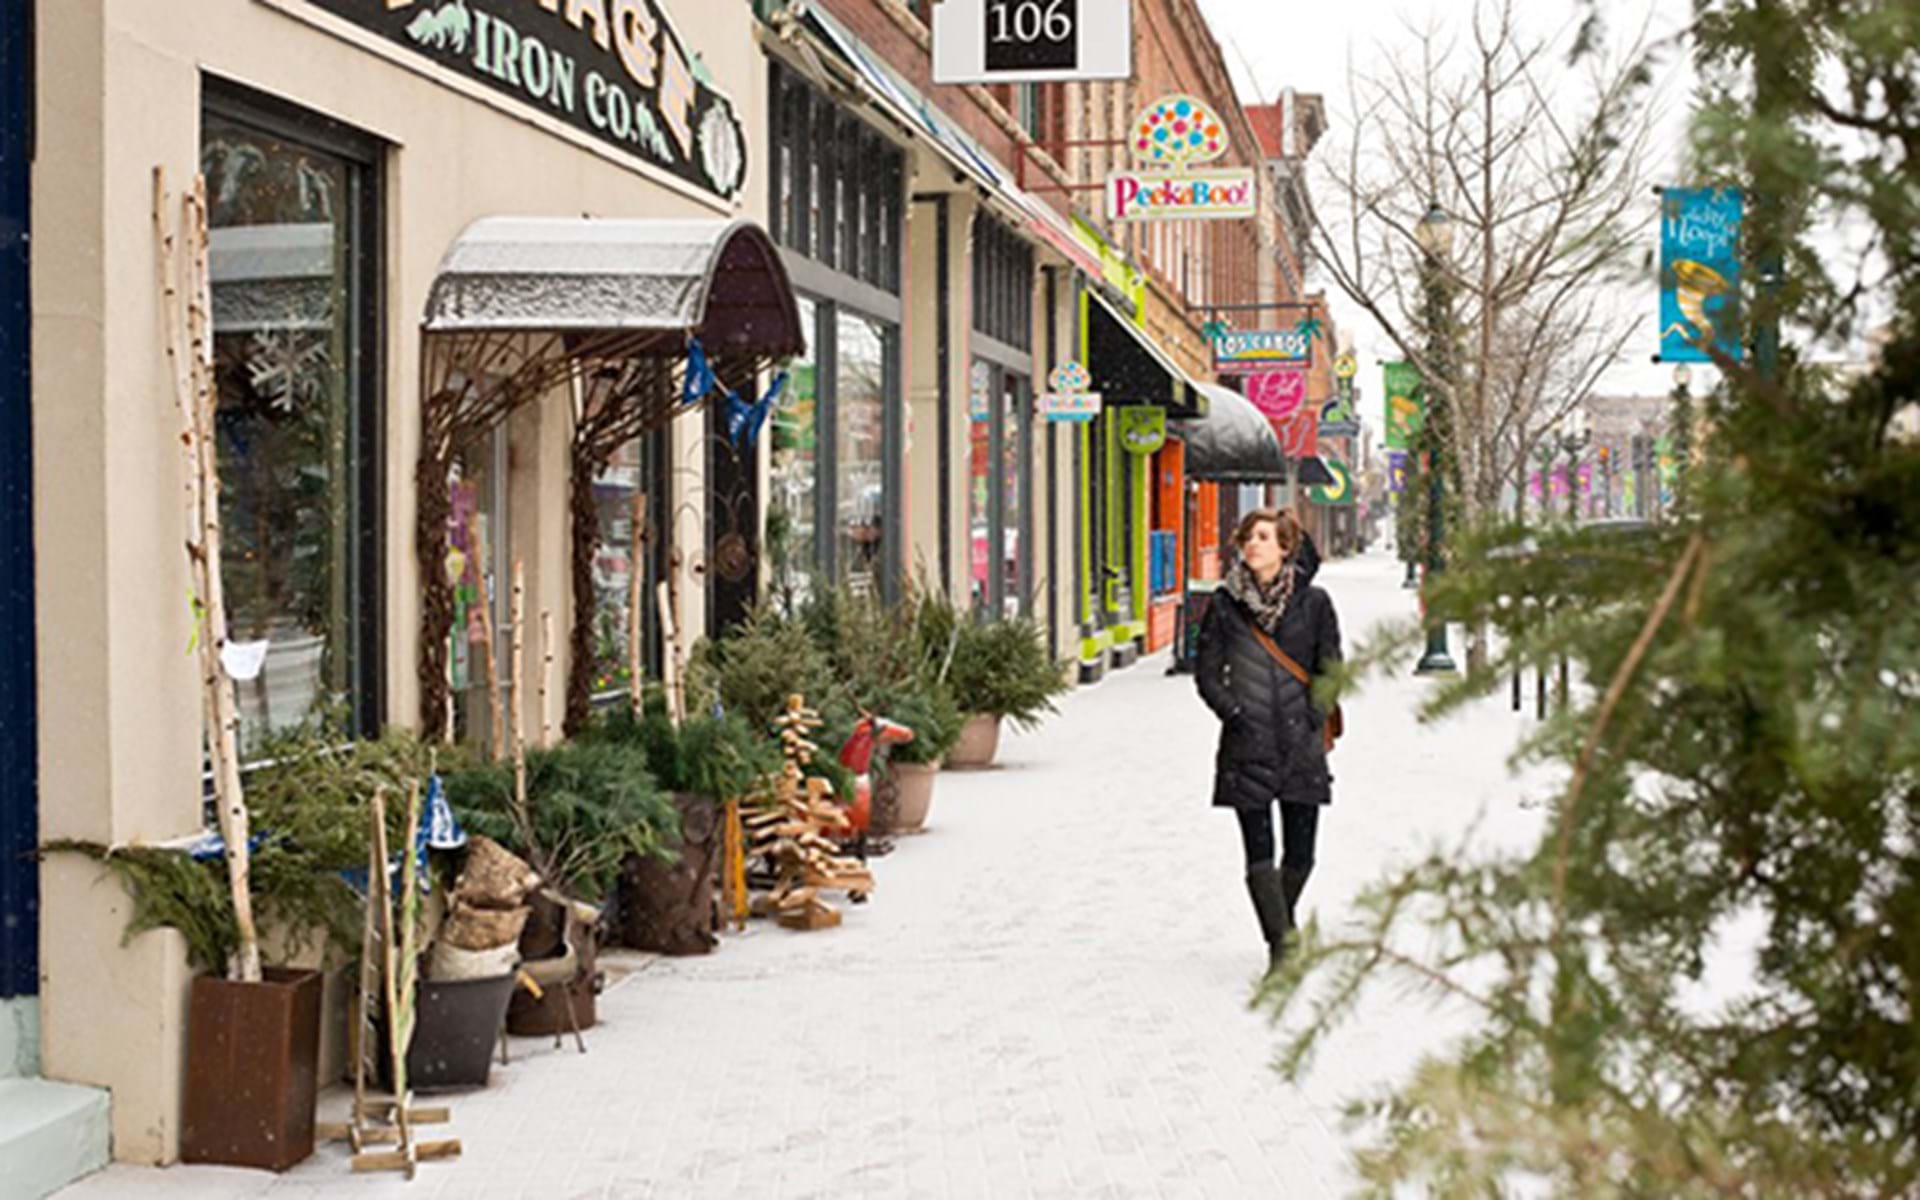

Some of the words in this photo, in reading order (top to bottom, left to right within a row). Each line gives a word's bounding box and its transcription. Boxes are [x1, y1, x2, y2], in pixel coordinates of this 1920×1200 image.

[990, 1, 1072, 43] 106
[472, 8, 575, 113] IRON
[1216, 336, 1247, 357] LOS
[1251, 335, 1306, 355] CABOS
